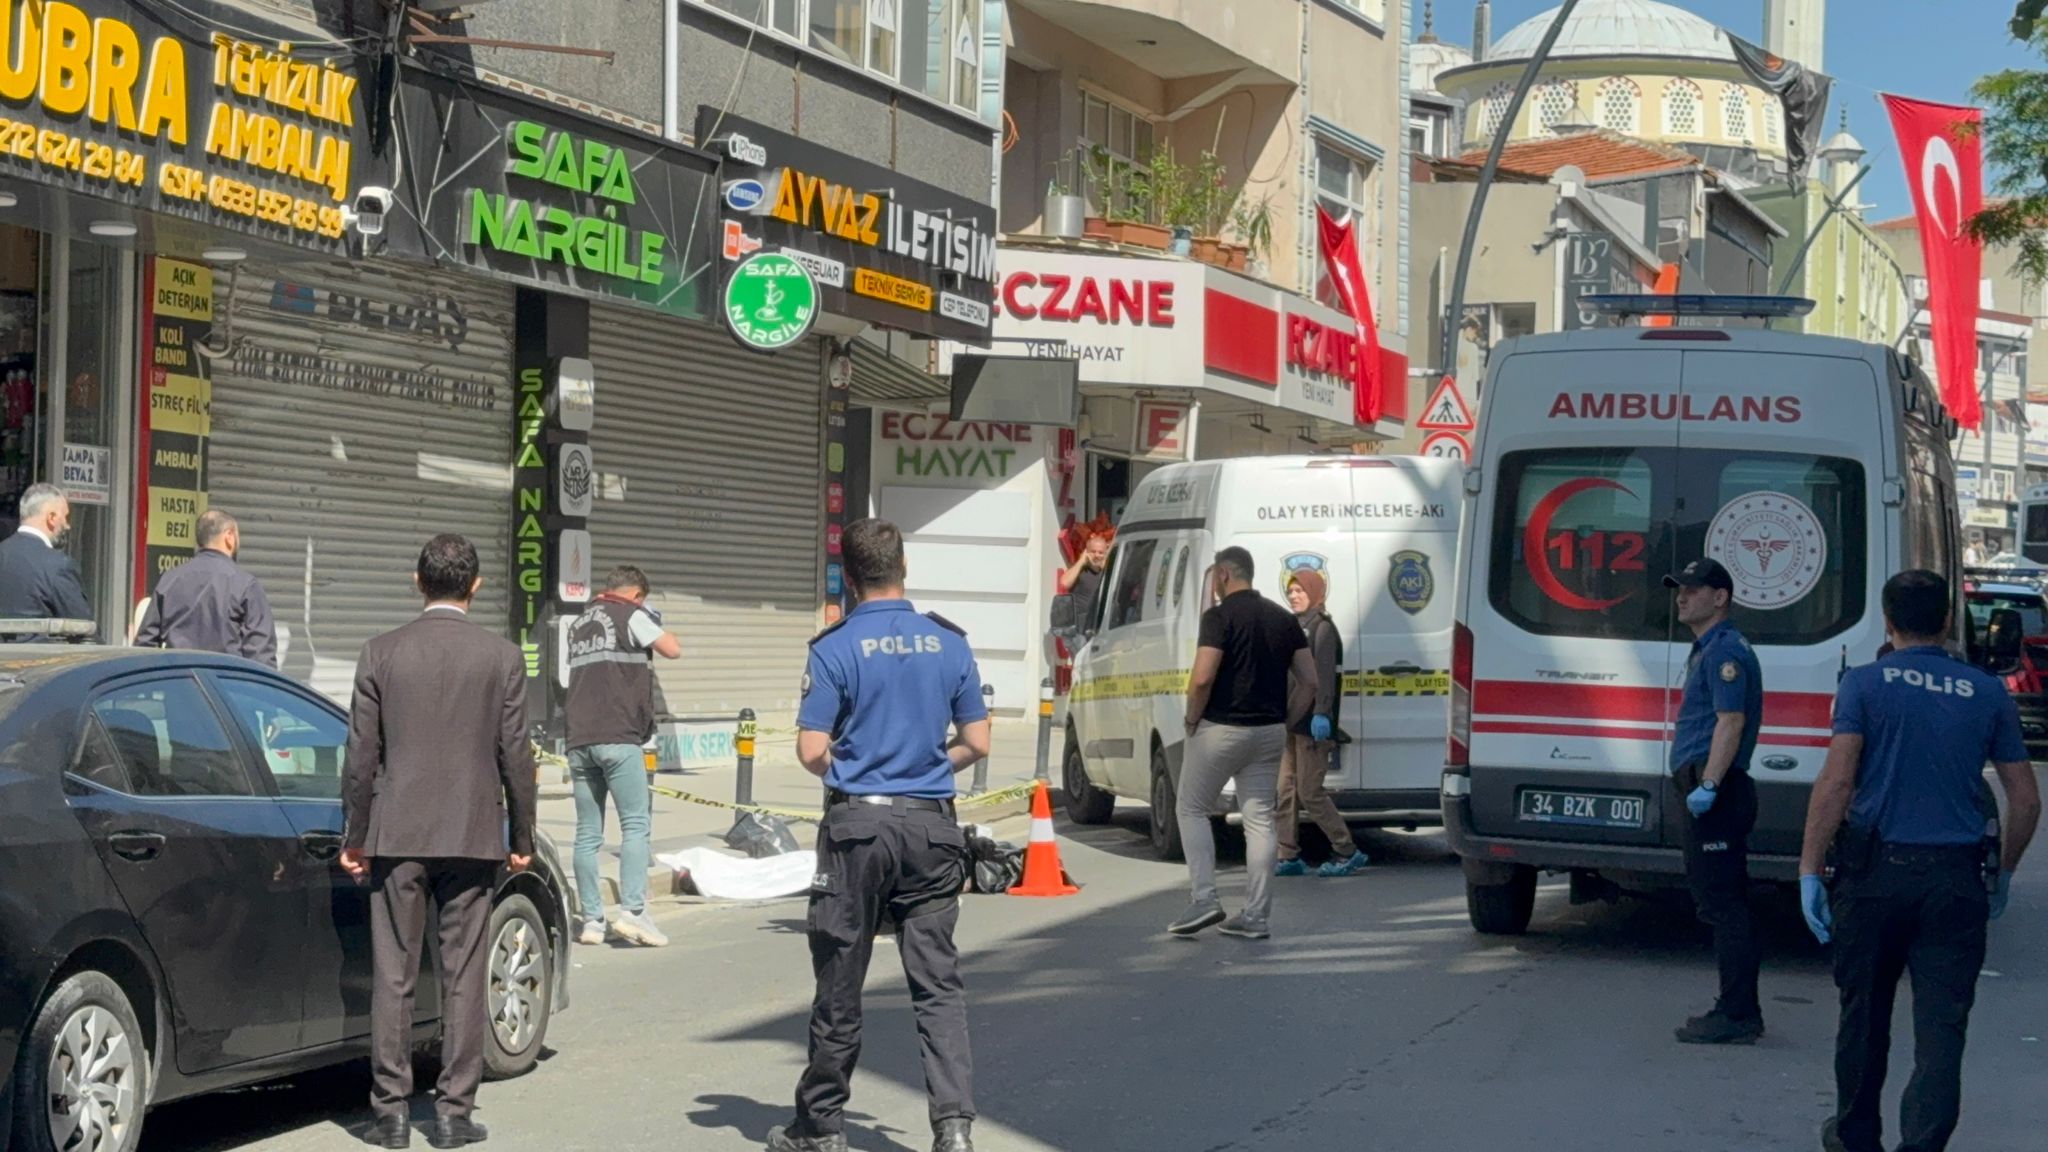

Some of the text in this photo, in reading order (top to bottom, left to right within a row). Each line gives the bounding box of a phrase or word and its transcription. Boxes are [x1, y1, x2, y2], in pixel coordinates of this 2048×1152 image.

[210, 31, 357, 127] TEMİZLİK
[37, 129, 81, 171] 624
[83, 141, 113, 179] 29
[206, 102, 349, 201] AMBALAJ
[504, 119, 636, 205] SAFA
[467, 187, 665, 286] NARGİLE
[771, 167, 880, 246] AYVAZ
[887, 187, 998, 290] İLETİŞİM
[172, 267, 196, 288] AÇIK
[744, 264, 802, 277] SAFA
[158, 289, 209, 313] DETERJAN
[861, 272, 927, 306] TEKNİK SERVİS
[159, 326, 183, 346] KOLİ
[731, 304, 809, 343] NARGİLE
[155, 349, 187, 367] BANDI
[1070, 345, 1125, 362] HAYAT
[151, 393, 184, 416] STREÇ
[1547, 392, 1802, 423] AMBULANS
[1149, 409, 1181, 448] E
[896, 446, 1016, 478] HAYAT
[161, 497, 196, 515] HASTA
[1257, 505, 1297, 520] OLAY
[166, 519, 189, 538] BEZİ
[517, 368, 545, 677] SAFA NARGİLE
[1547, 531, 1646, 571] 112
[1532, 794, 1641, 820] 34 BZK 001
